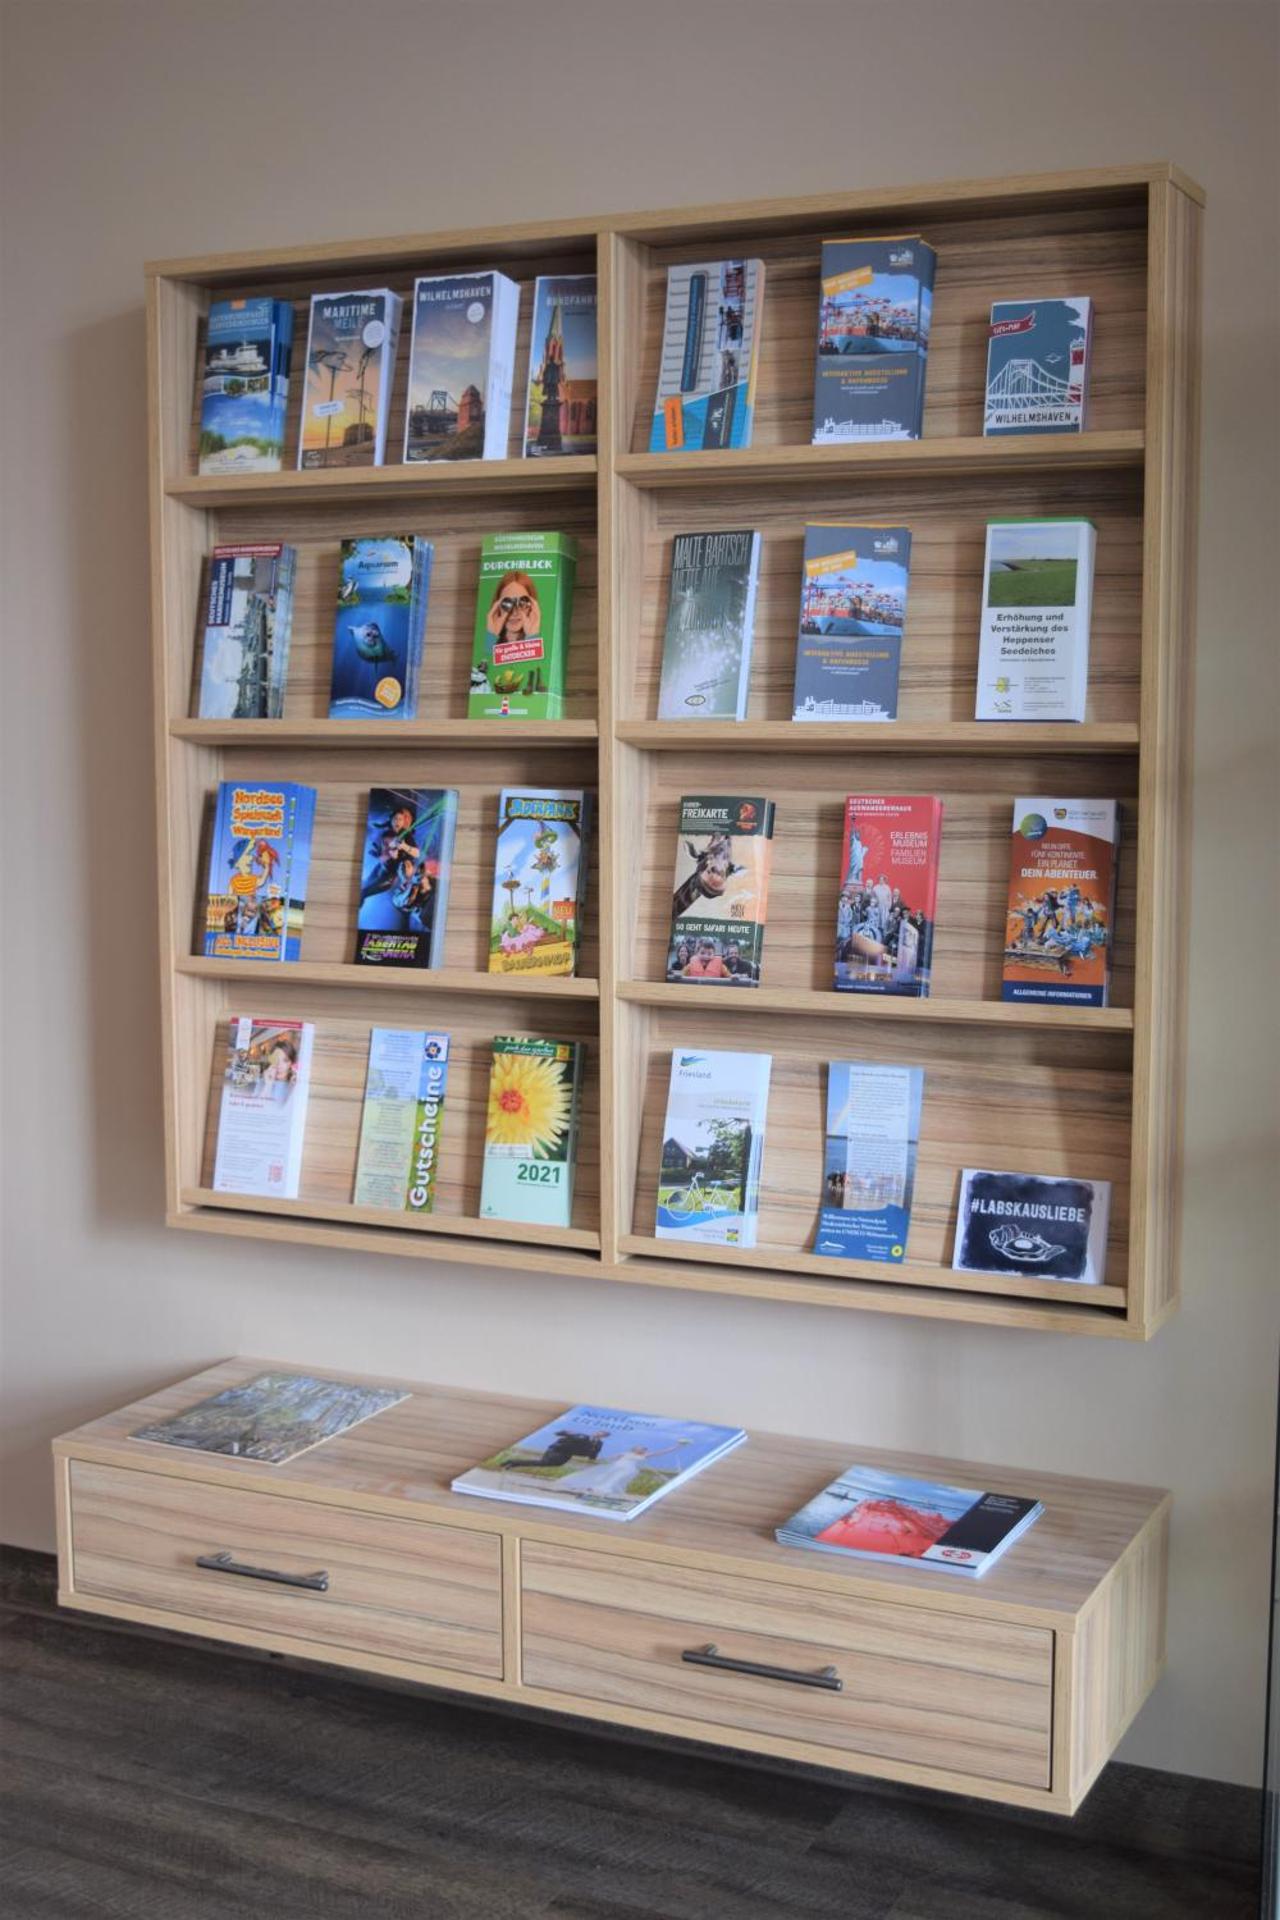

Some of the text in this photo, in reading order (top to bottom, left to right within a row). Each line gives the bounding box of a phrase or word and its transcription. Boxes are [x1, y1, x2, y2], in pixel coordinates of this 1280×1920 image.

[419, 286, 491, 302] WILHELMSHAVEN
[322, 303, 376, 319] MARITIME
[995, 411, 1071, 424] WILHELMSHAVEN
[674, 533, 750, 568] MALTE BARTSCH
[358, 561, 398, 571] Aquarium
[483, 560, 552, 571] DURCHBLICK
[996, 612, 1064, 624] Erhöhung und
[991, 624, 1068, 634] Verstärkung des
[1003, 636, 1055, 645] Heppenser
[1001, 647, 1056, 655] Seedeiches
[233, 790, 284, 805] Nordsee
[682, 808, 729, 819] FREIKARTE
[892, 839, 928, 848] MUSEUM
[892, 856, 926, 865] MUSEUM
[1021, 868, 1043, 878] DEIN
[685, 923, 702, 931] GEHT
[703, 924, 725, 932] SAFARI
[728, 925, 751, 934] HEUTE
[679, 1070, 712, 1079] Friesland
[410, 1066, 443, 1207] Gutscheine
[518, 1163, 561, 1184] 2021
[971, 1198, 1086, 1223] #LABSKAUSLIEBE
